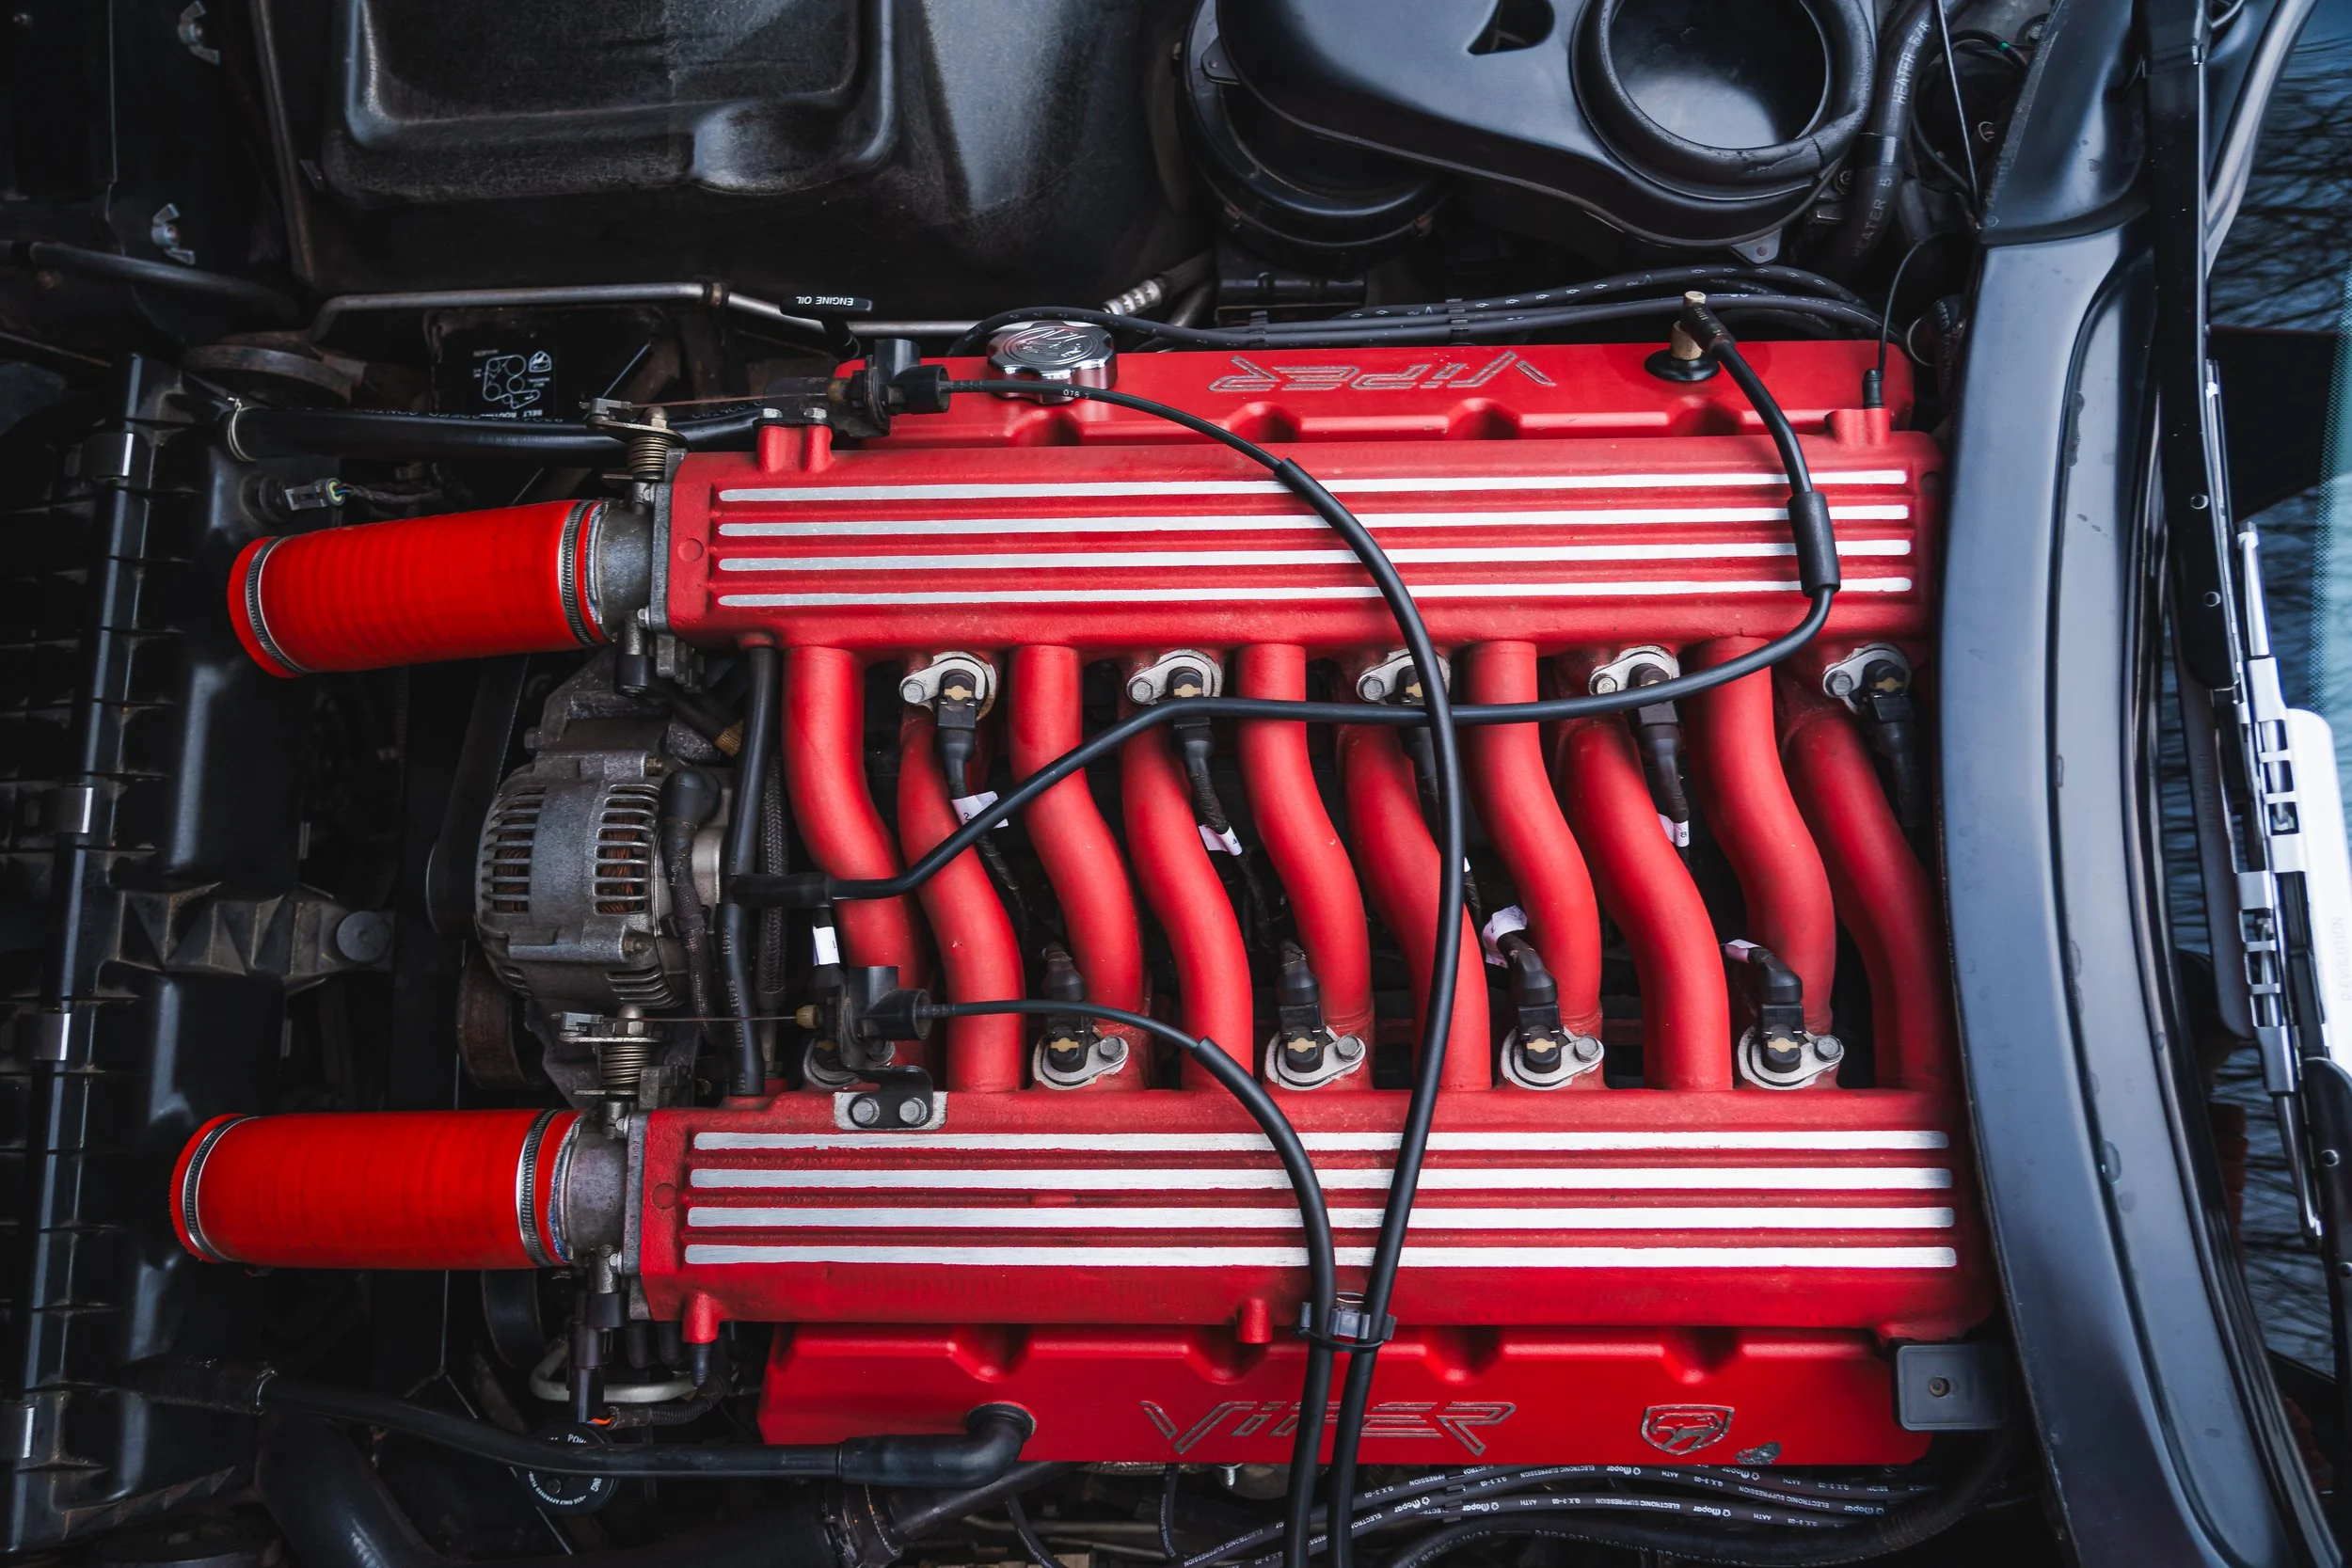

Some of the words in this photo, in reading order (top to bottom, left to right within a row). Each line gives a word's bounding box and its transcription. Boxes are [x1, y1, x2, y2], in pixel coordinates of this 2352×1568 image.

[1892, 52, 1917, 106] HEATER
[796, 296, 813, 305] OIL
[816, 296, 854, 307] ENGINE
[1519, 1467, 1561, 1479] SUPPRESSION
[1561, 1465, 1597, 1474] ELECTRONIC
[1606, 1465, 1632, 1476] Mopar
[1661, 1470, 1679, 1480] AATH
[1408, 1473, 1447, 1486] PPRESSION
[1739, 1485, 1787, 1501] SUPPRESSION
[1519, 1498, 1538, 1507] AATH
[1595, 1497, 1640, 1506] SUPPRESSION
[1640, 1499, 1681, 1510] ELECTRONIC
[1786, 1496, 1830, 1509] ELECTRONIC
[1393, 1501, 1422, 1514] Mopar
[1462, 1503, 1491, 1513] Mopar
[1692, 1505, 1722, 1516] Mopar
[1843, 1504, 1874, 1514] Mopar
[1753, 1513, 1772, 1522] AATH
[1224, 1528, 1263, 1549] ELECTRONIC
[1184, 1544, 1225, 1568] SUPPRESSION
